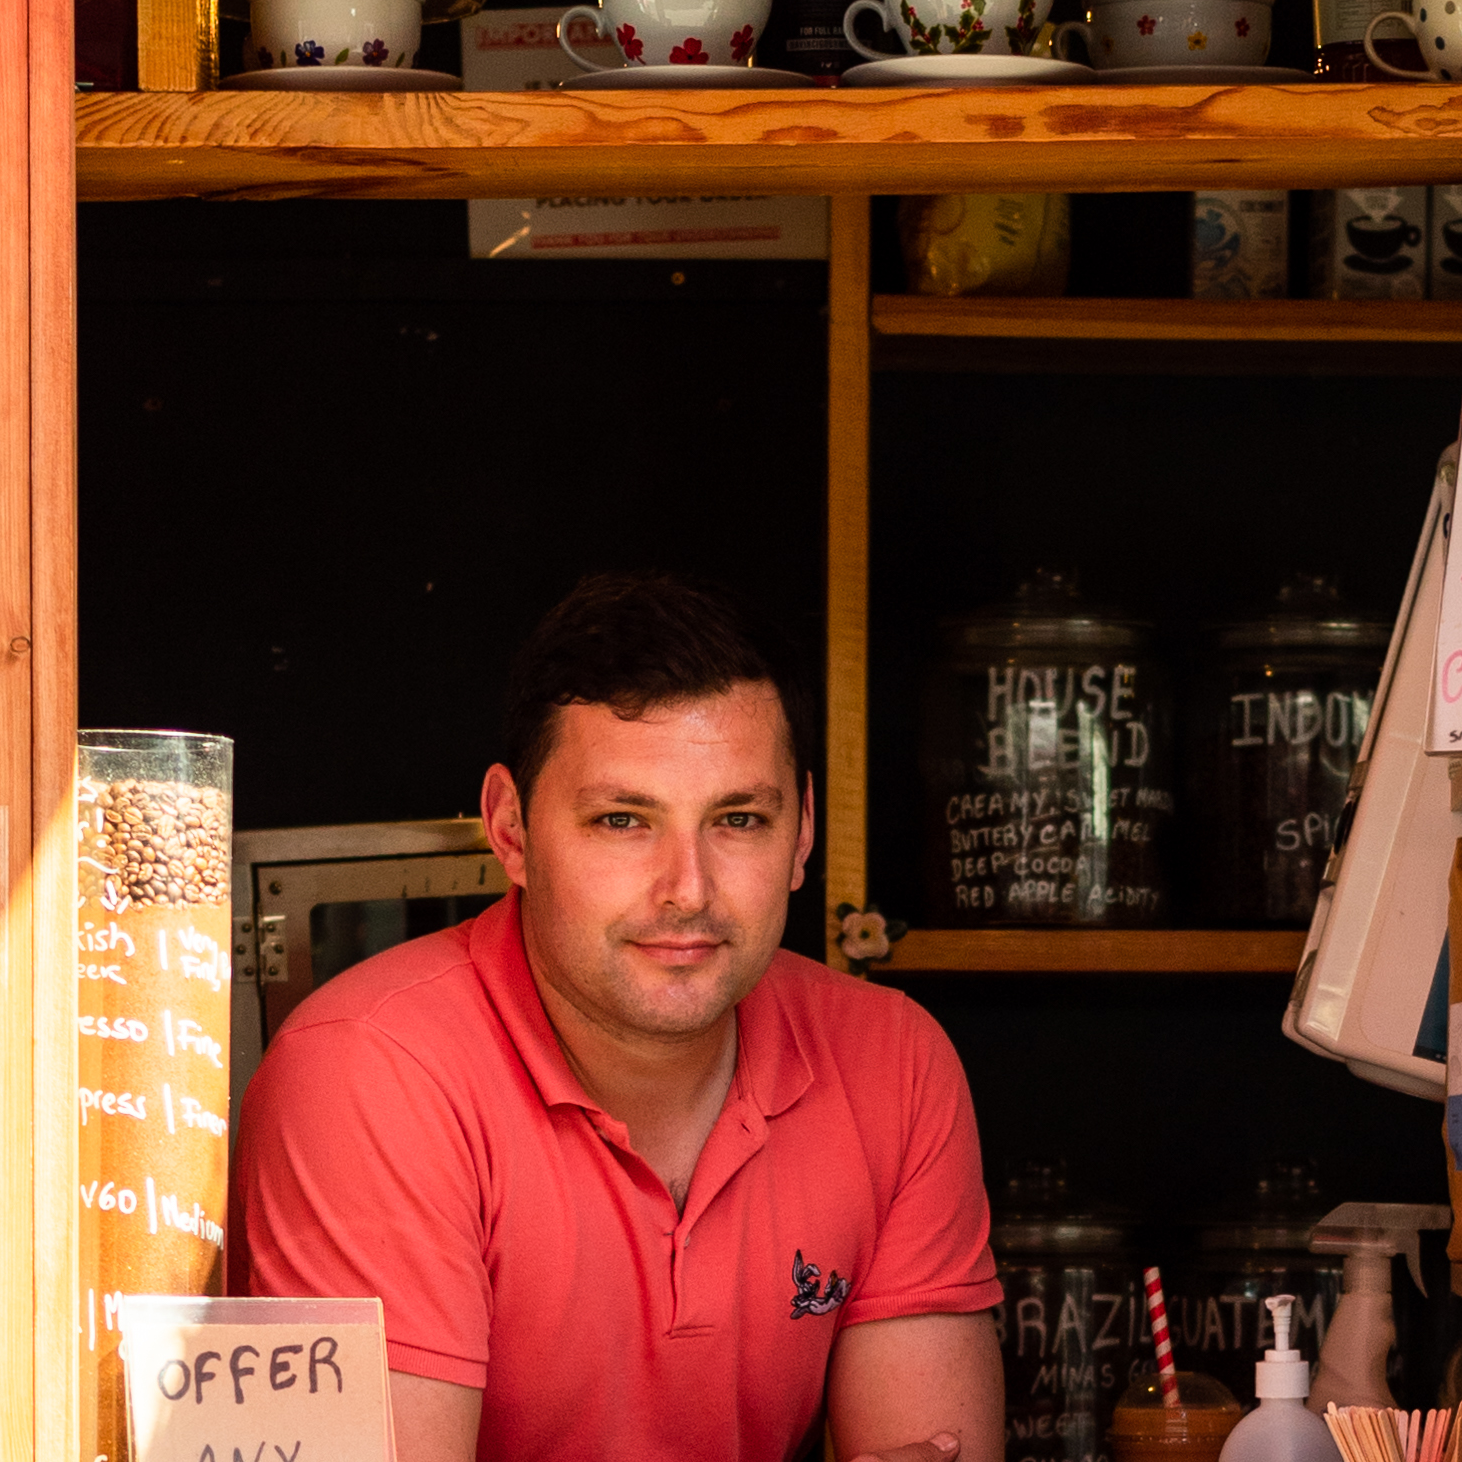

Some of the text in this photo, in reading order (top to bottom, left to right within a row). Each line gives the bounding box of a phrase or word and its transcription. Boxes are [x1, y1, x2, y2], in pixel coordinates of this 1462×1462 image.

[987, 664, 1137, 722] HOUSE
[950, 851, 1008, 883] DEEP
[955, 884, 996, 910] RED
[1008, 880, 1077, 904] APPLE
[158, 1336, 344, 1405] OFFER
